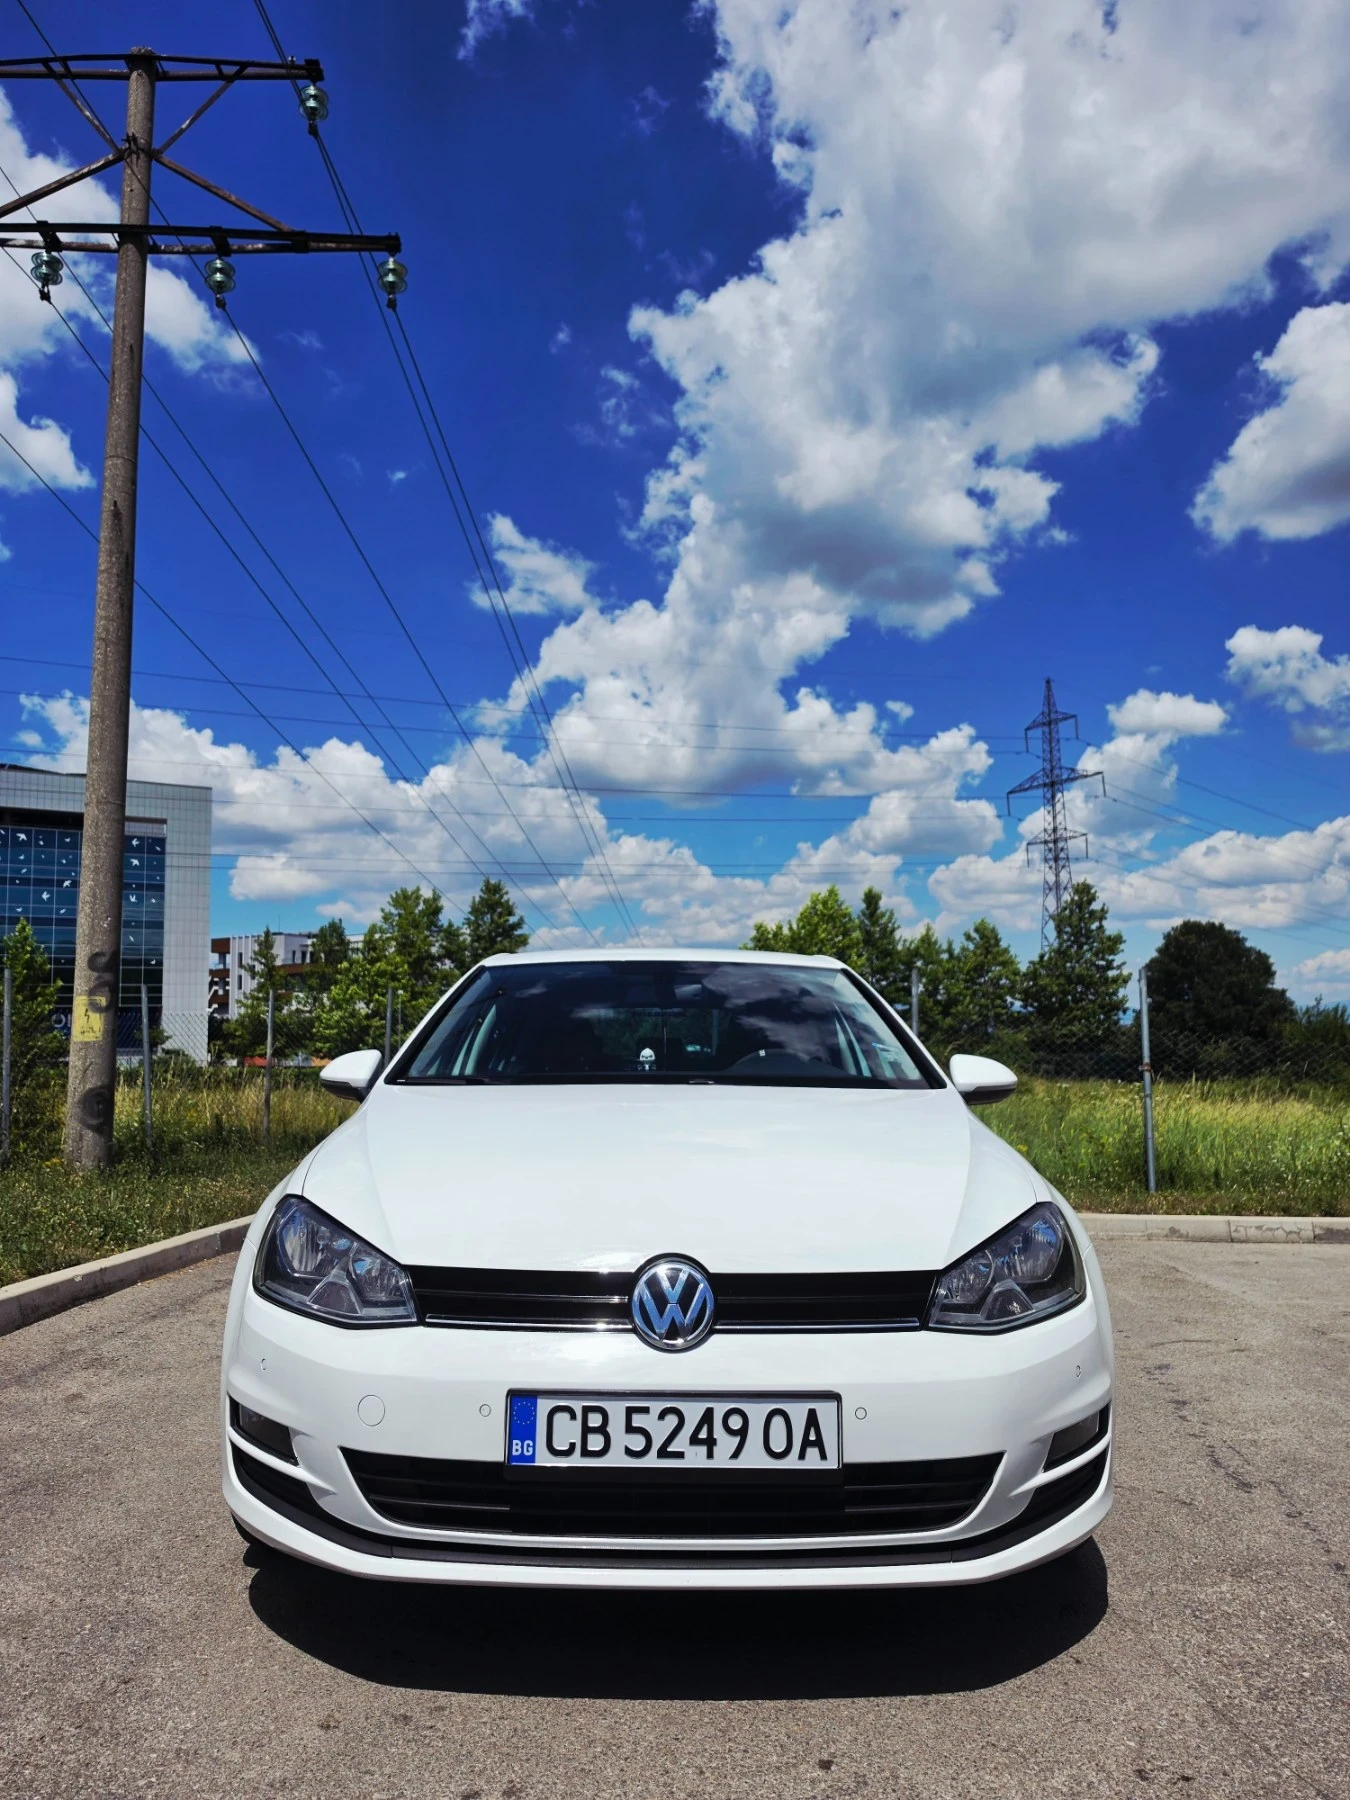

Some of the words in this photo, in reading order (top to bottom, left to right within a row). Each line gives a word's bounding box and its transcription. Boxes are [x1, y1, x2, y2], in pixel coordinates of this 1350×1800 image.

[512, 1439, 534, 1456] BG
[546, 1404, 612, 1458] CB
[624, 1405, 750, 1460] 5249
